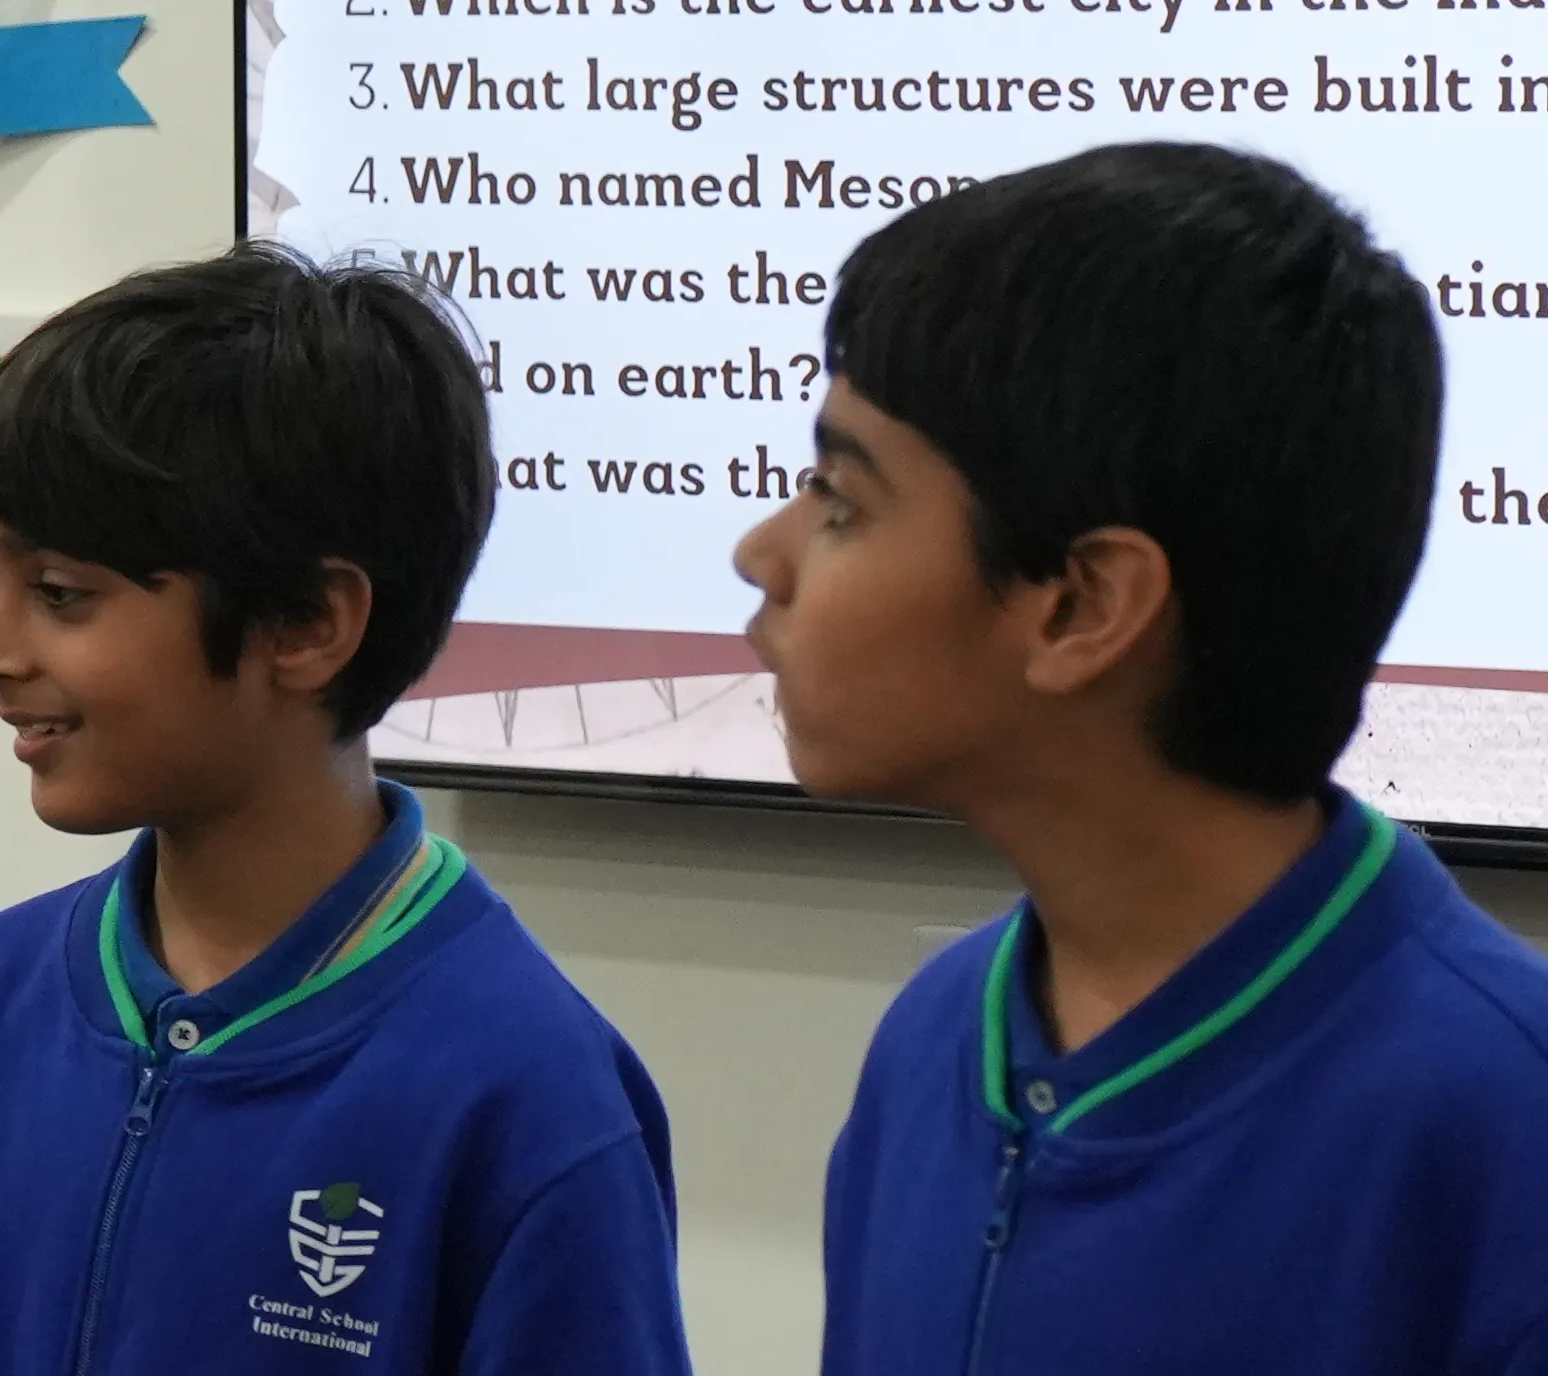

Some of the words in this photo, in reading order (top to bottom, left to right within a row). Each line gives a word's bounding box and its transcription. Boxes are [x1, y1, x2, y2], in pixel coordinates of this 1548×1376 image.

[349, 62, 389, 110] 3.
[399, 57, 565, 111] What
[586, 57, 739, 132] large
[763, 70, 1095, 112] structures
[1118, 77, 1289, 112] were
[1314, 55, 1473, 112] built
[348, 156, 389, 204] 4.
[400, 152, 537, 205] Who
[559, 154, 761, 208] named
[401, 246, 566, 300] What
[586, 268, 705, 303] was
[727, 251, 827, 305] the
[526, 362, 595, 396] on
[618, 346, 821, 402] earth?
[499, 452, 567, 491] at
[587, 459, 705, 496] was
[248, 1293, 315, 1321] Central
[318, 1307, 380, 1337] School
[252, 1315, 372, 1358] International
